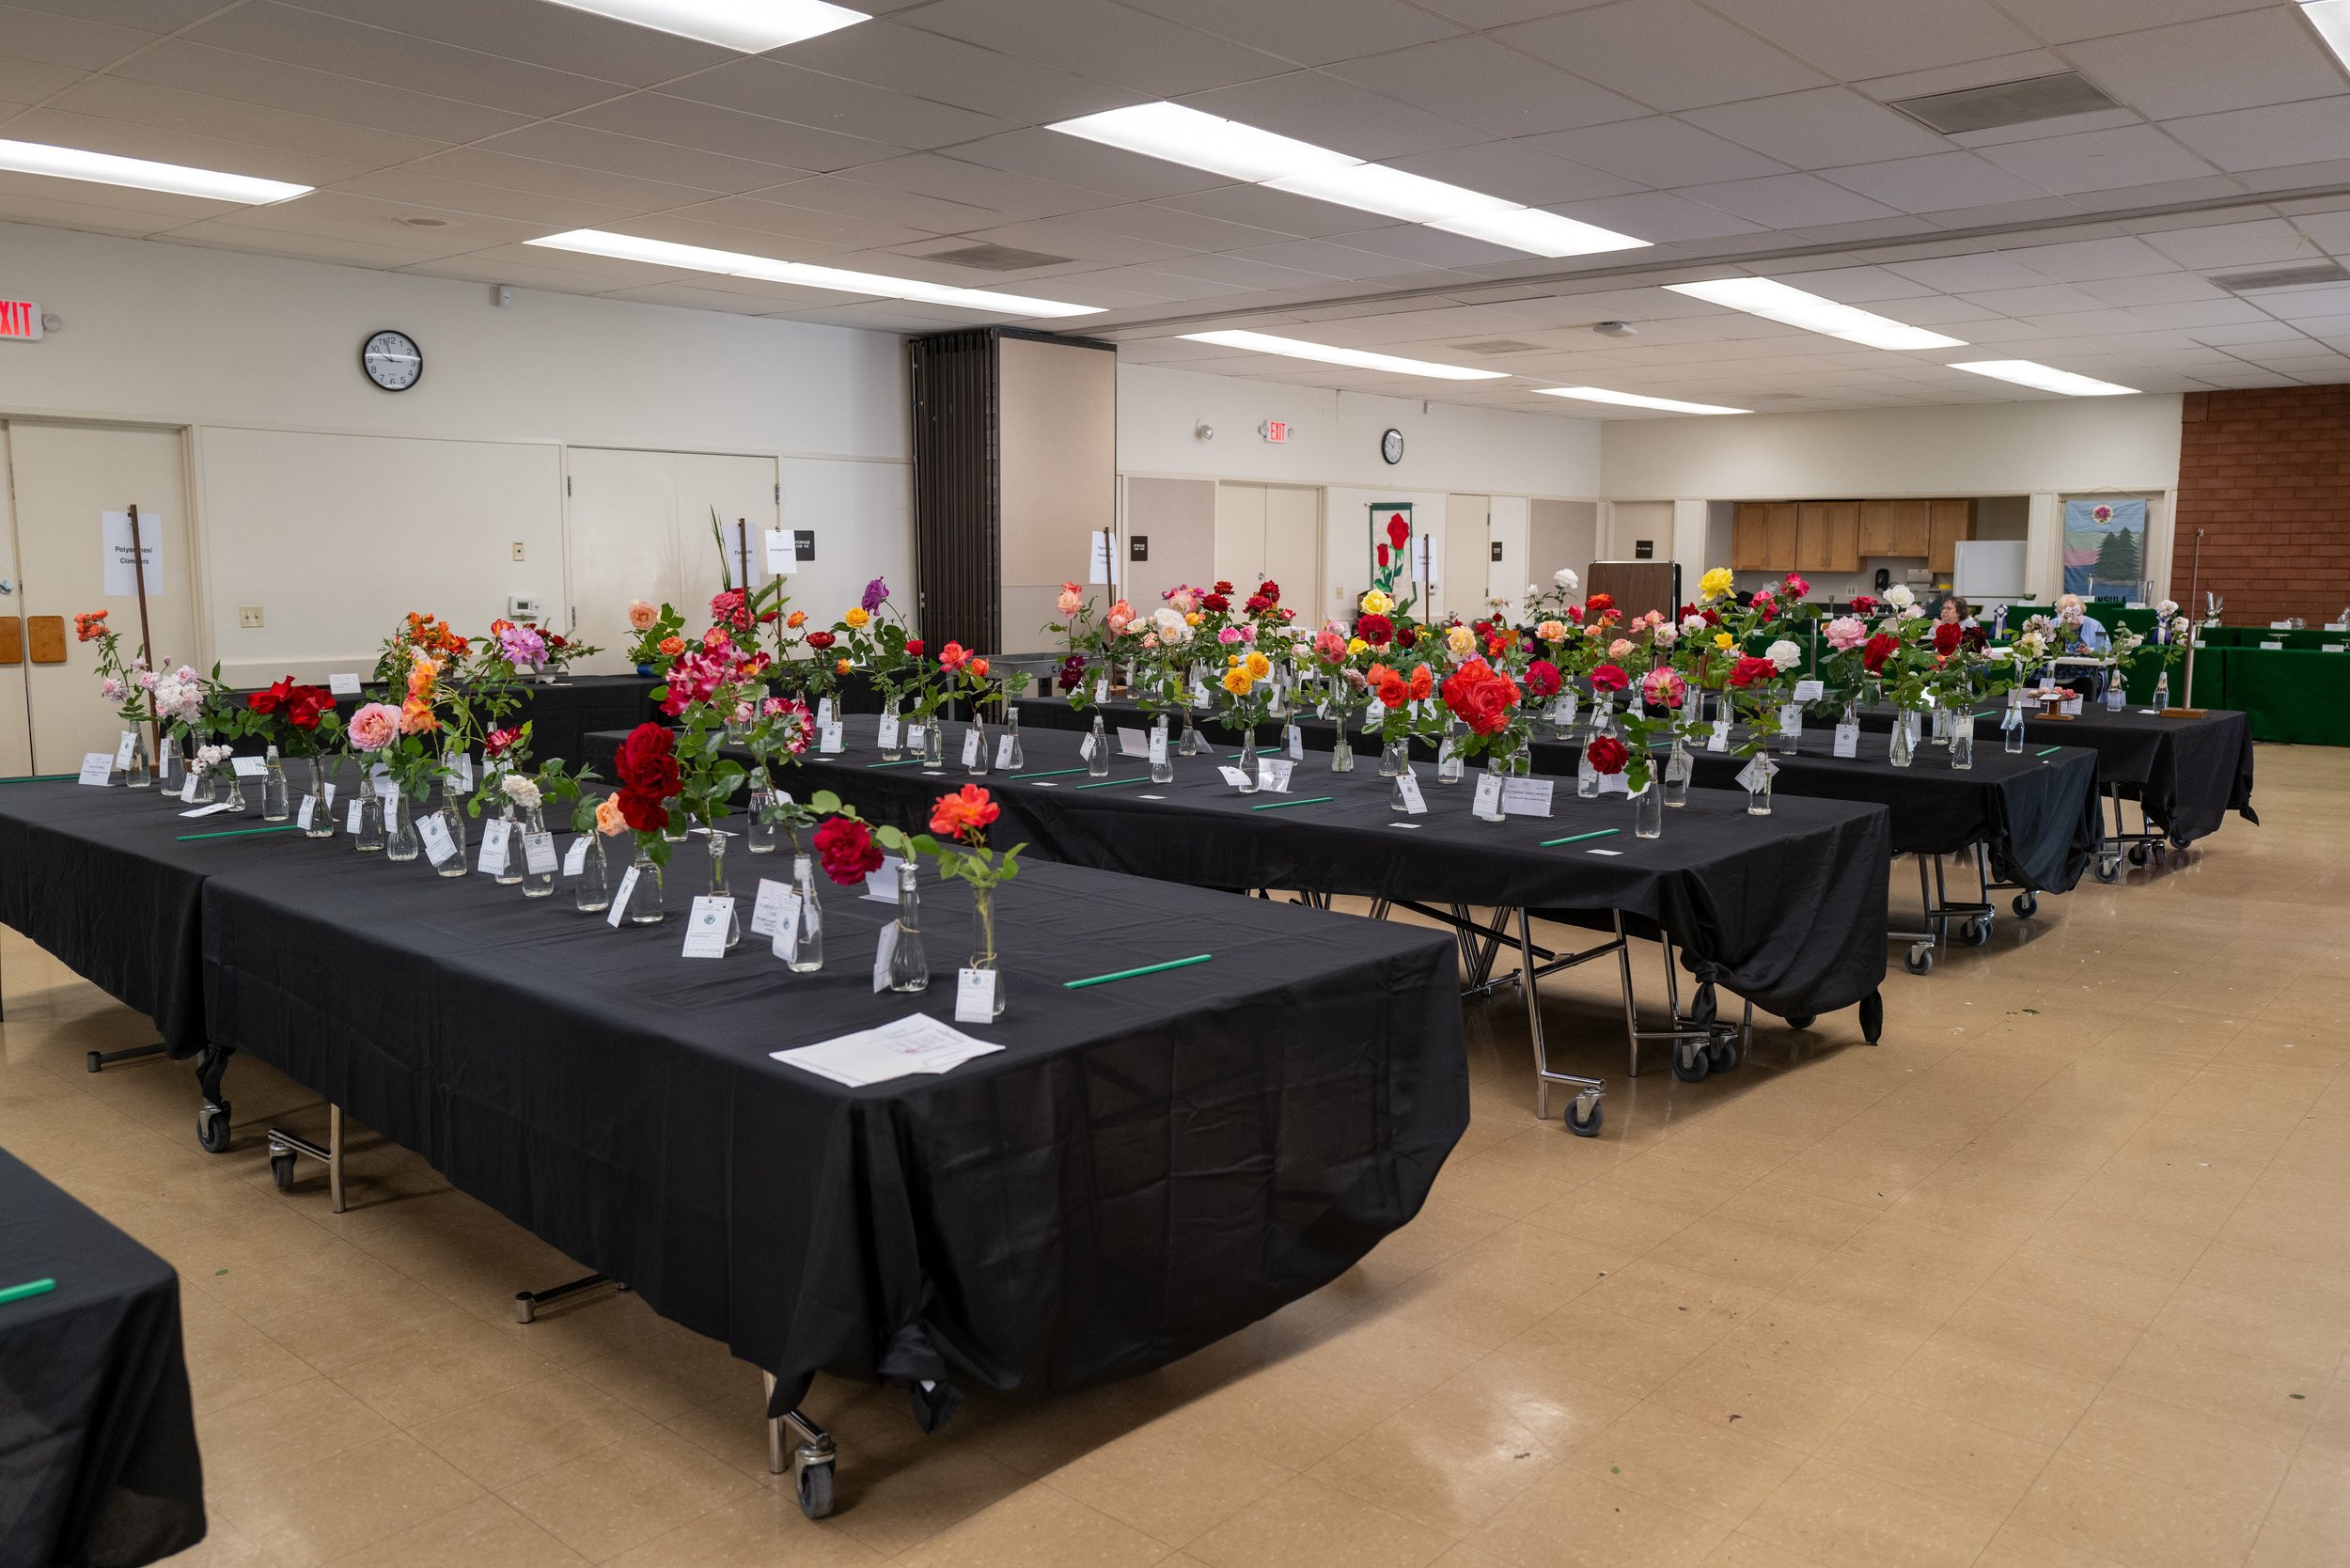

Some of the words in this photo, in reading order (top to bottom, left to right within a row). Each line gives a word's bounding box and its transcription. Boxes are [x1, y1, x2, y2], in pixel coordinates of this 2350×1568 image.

[379, 337, 386, 346] 11
[387, 337, 396, 345] 12
[371, 345, 380, 353] 10
[406, 348, 413, 356] 2
[368, 355, 373, 364] 9
[411, 359, 416, 368] 3
[371, 366, 377, 374] 8
[380, 373, 385, 382] 7
[400, 376, 406, 384] 5
[1270, 421, 1286, 442] EXIT
